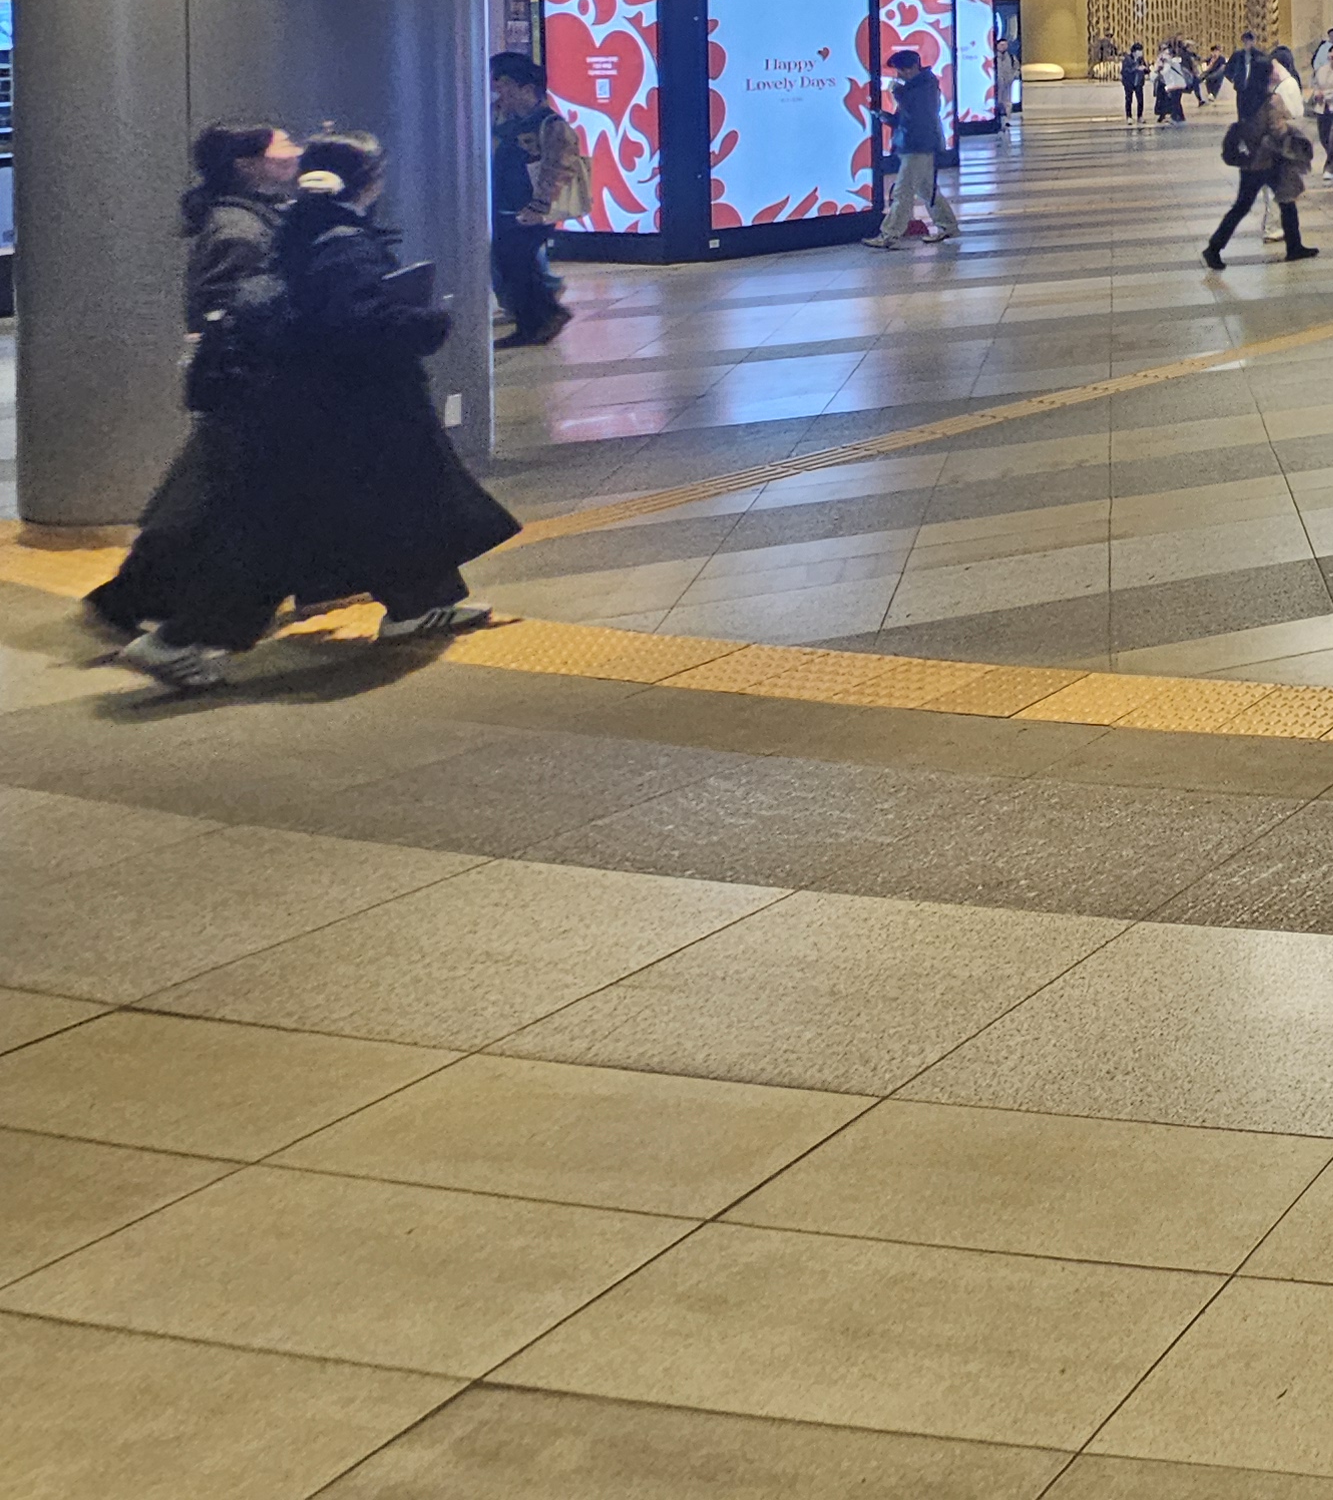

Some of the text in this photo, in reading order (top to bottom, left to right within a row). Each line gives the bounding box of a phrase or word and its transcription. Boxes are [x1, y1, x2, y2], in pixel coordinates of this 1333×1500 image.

[764, 58, 816, 73] Happy
[745, 76, 837, 92] Lovely Days
